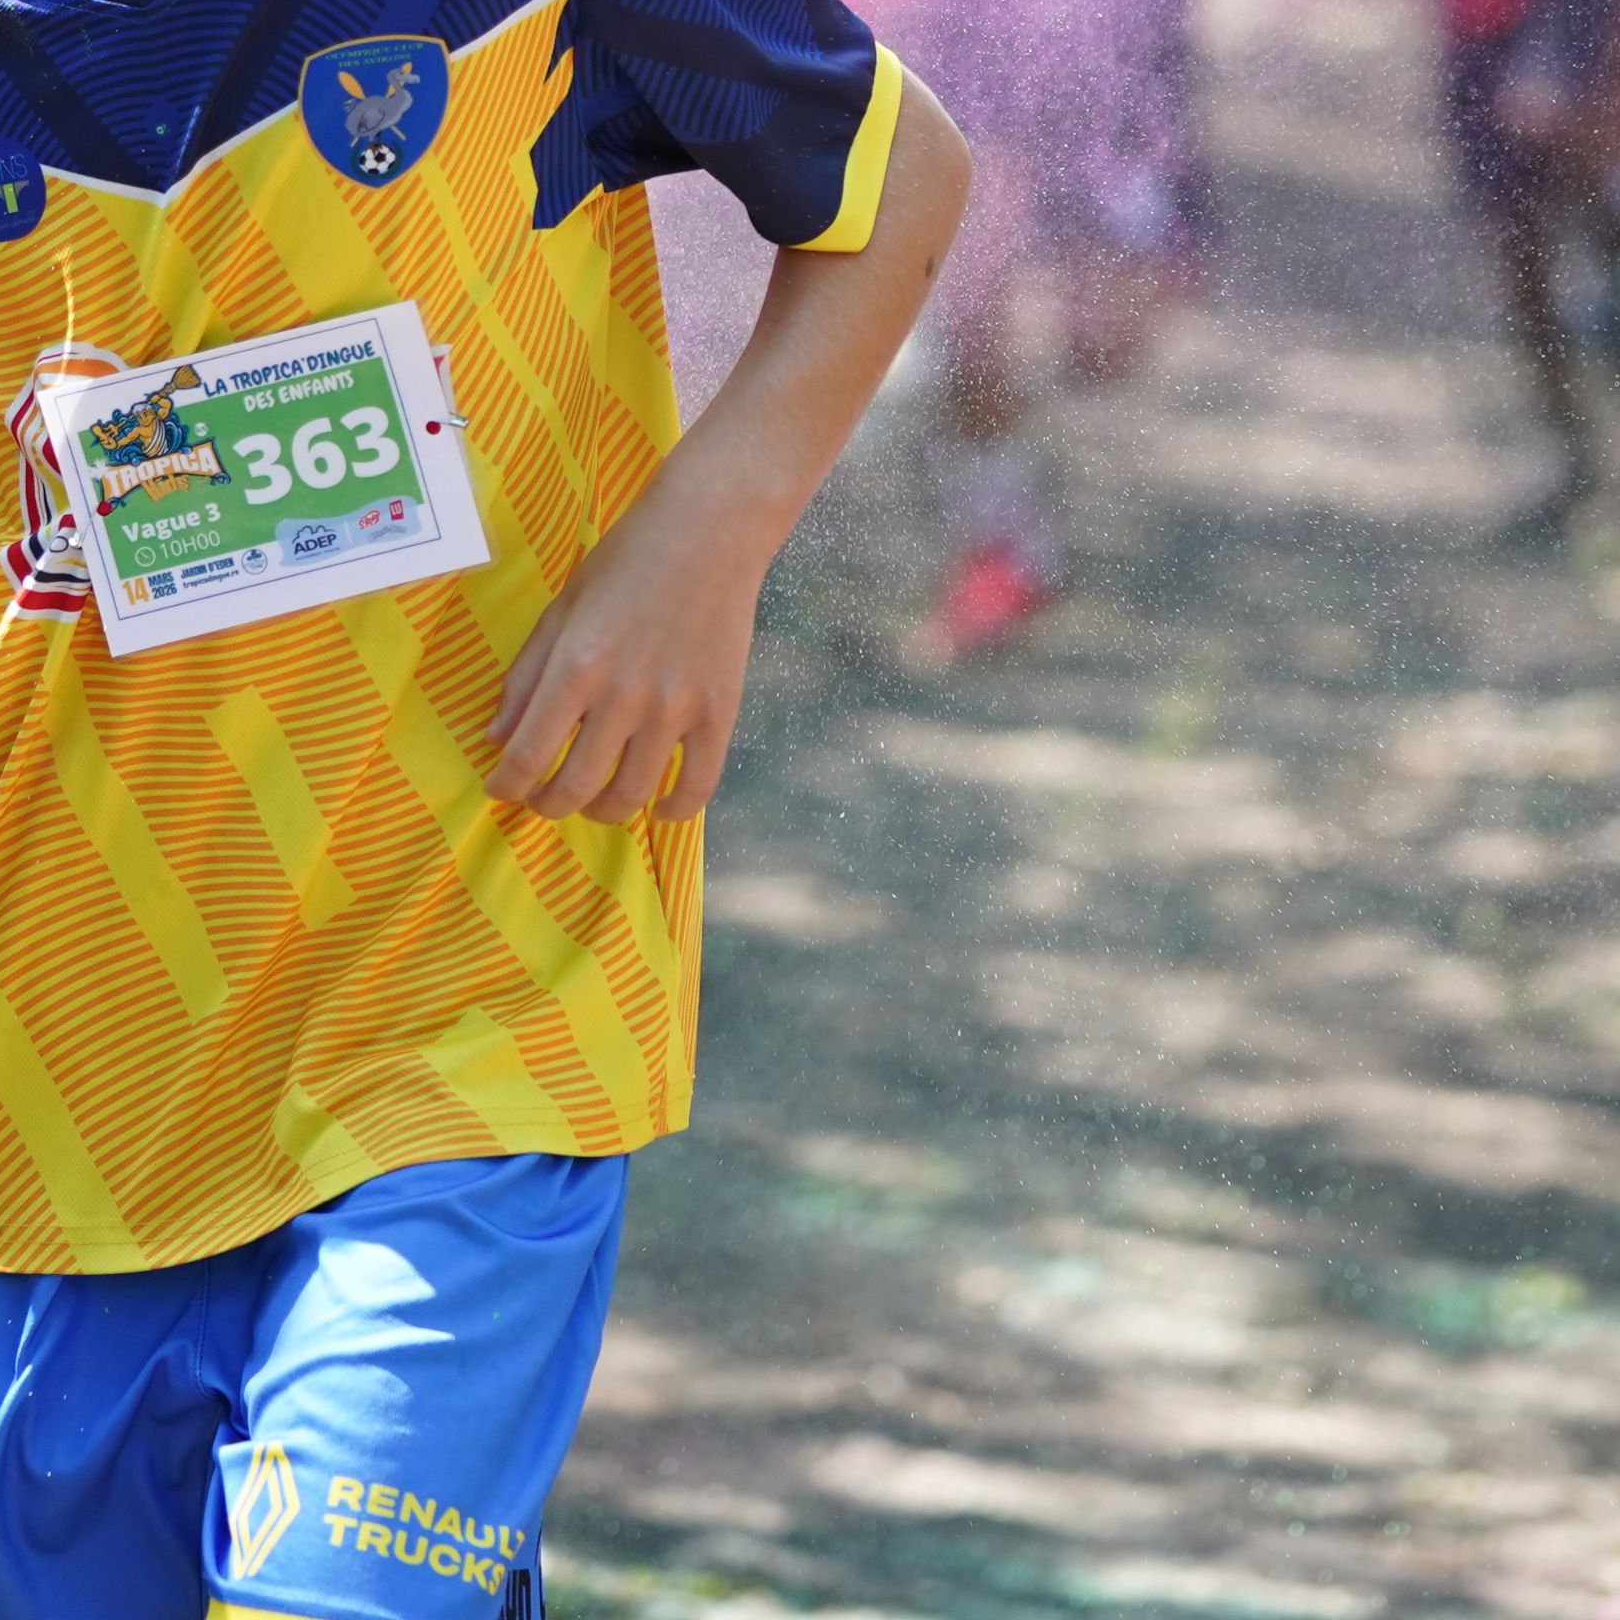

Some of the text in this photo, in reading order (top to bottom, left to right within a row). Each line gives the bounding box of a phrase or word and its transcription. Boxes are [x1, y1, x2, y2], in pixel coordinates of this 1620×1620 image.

[203, 377, 229, 398] LA
[243, 370, 355, 413] DES ENFANTS
[232, 406, 401, 506] 363
[104, 446, 223, 499] TROPICA
[121, 502, 221, 542] Vague 3
[159, 530, 221, 559] 10H00
[294, 533, 337, 555] ADEP
[148, 571, 174, 587] MARS
[181, 563, 208, 579] JARDIN
[122, 577, 150, 606] 14
[152, 583, 177, 599] 2026
